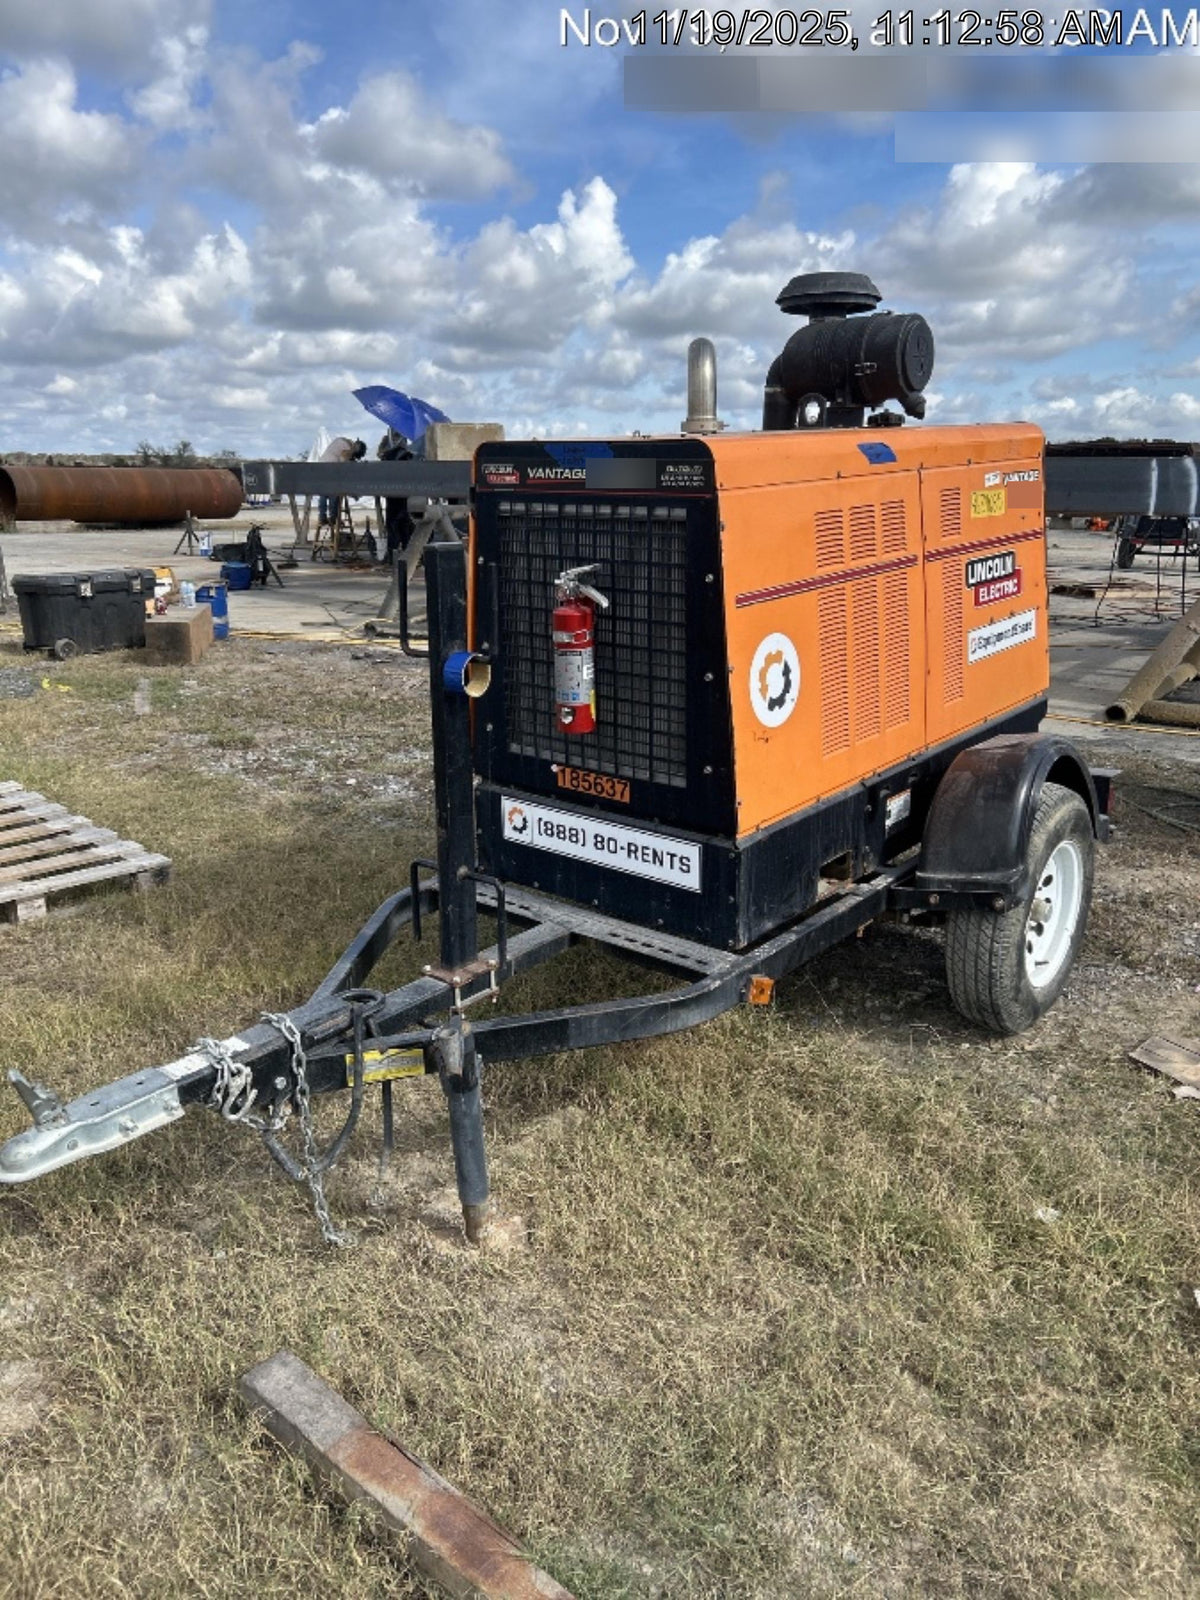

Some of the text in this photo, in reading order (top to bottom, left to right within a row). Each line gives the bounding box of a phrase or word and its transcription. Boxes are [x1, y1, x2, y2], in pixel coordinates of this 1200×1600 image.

[968, 554, 1013, 585] LINCOLN
[979, 578, 1018, 603] ELECTRIC
[559, 767, 629, 800] 185637
[537, 817, 587, 847] (888)
